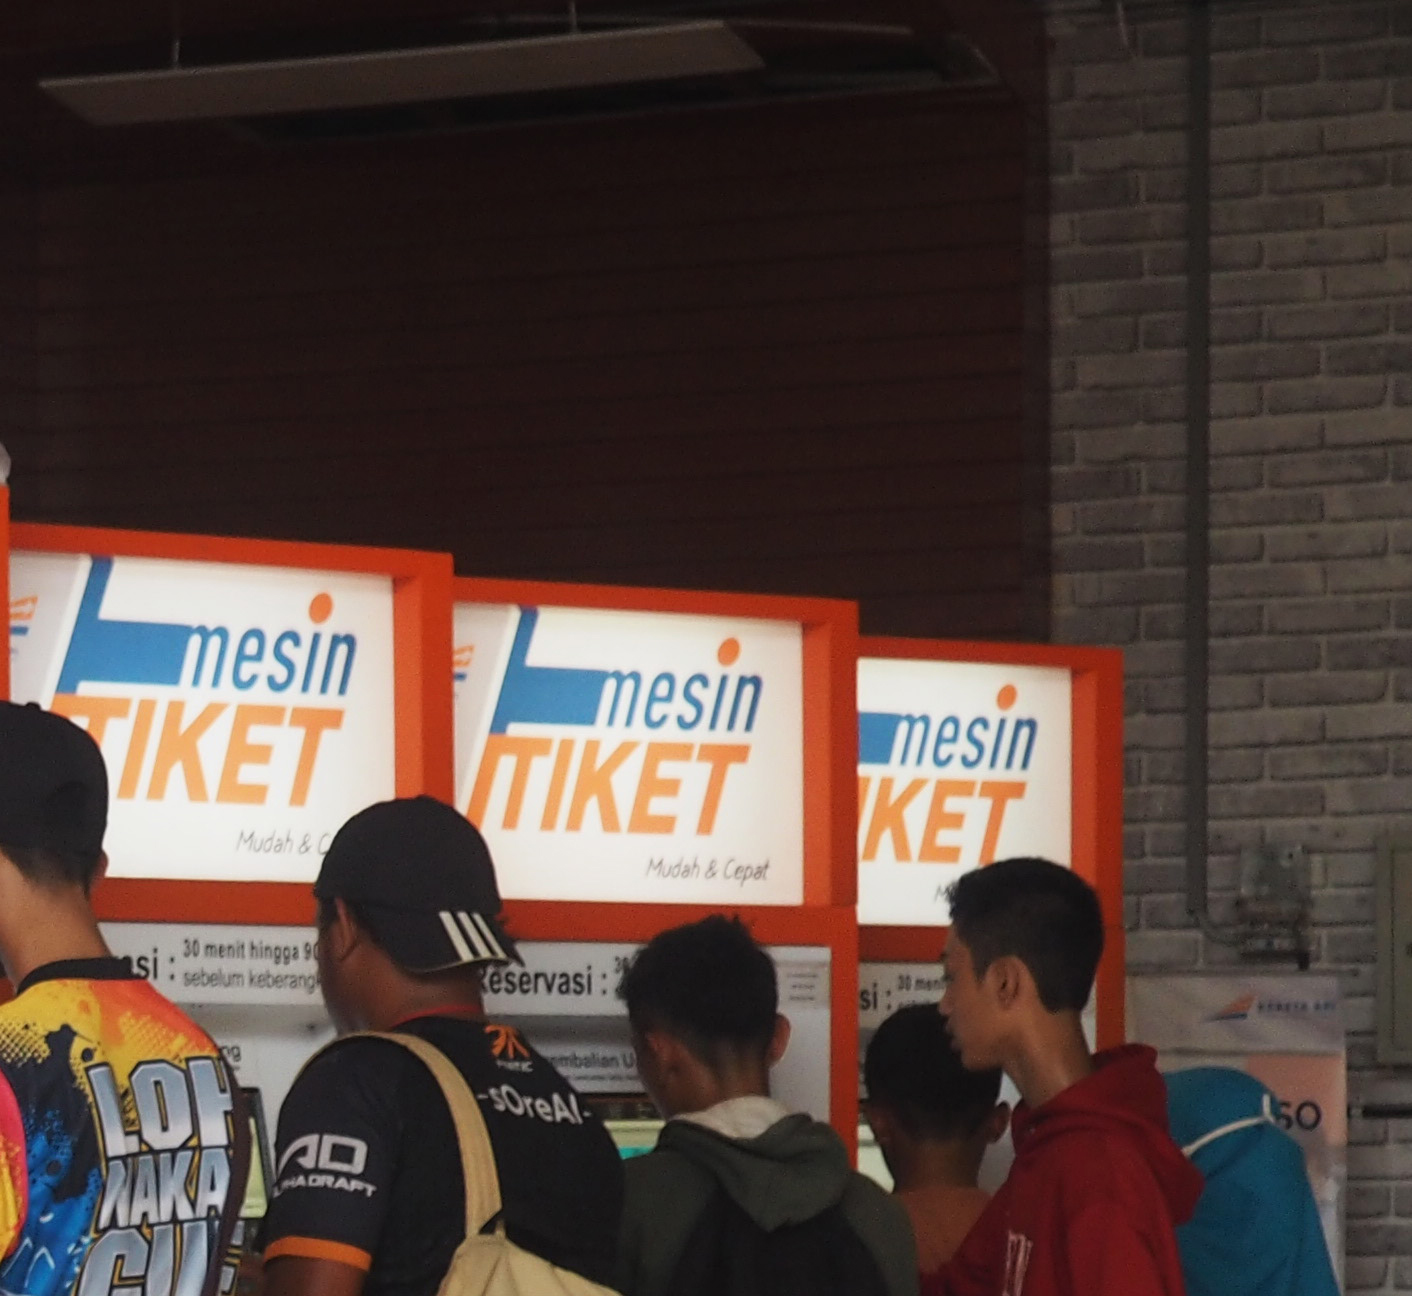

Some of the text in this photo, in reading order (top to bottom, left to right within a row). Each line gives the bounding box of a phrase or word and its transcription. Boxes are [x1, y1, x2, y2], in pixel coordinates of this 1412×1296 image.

[179, 592, 357, 696] mesin
[593, 637, 764, 733] mesin
[50, 692, 345, 807] TIKET
[888, 684, 1038, 771] mesin
[488, 734, 752, 836] TIKET
[859, 775, 1028, 866] KET
[237, 831, 292, 853] Mudah
[299, 835, 311, 854] &
[646, 857, 770, 887] Mudah & Cepat
[183, 938, 200, 958] 30
[204, 940, 246, 959] menit
[250, 940, 300, 966] hingga
[184, 966, 318, 995] sebelum keberang
[480, 964, 593, 996] eservasi
[98, 1148, 232, 1230] NAKA
